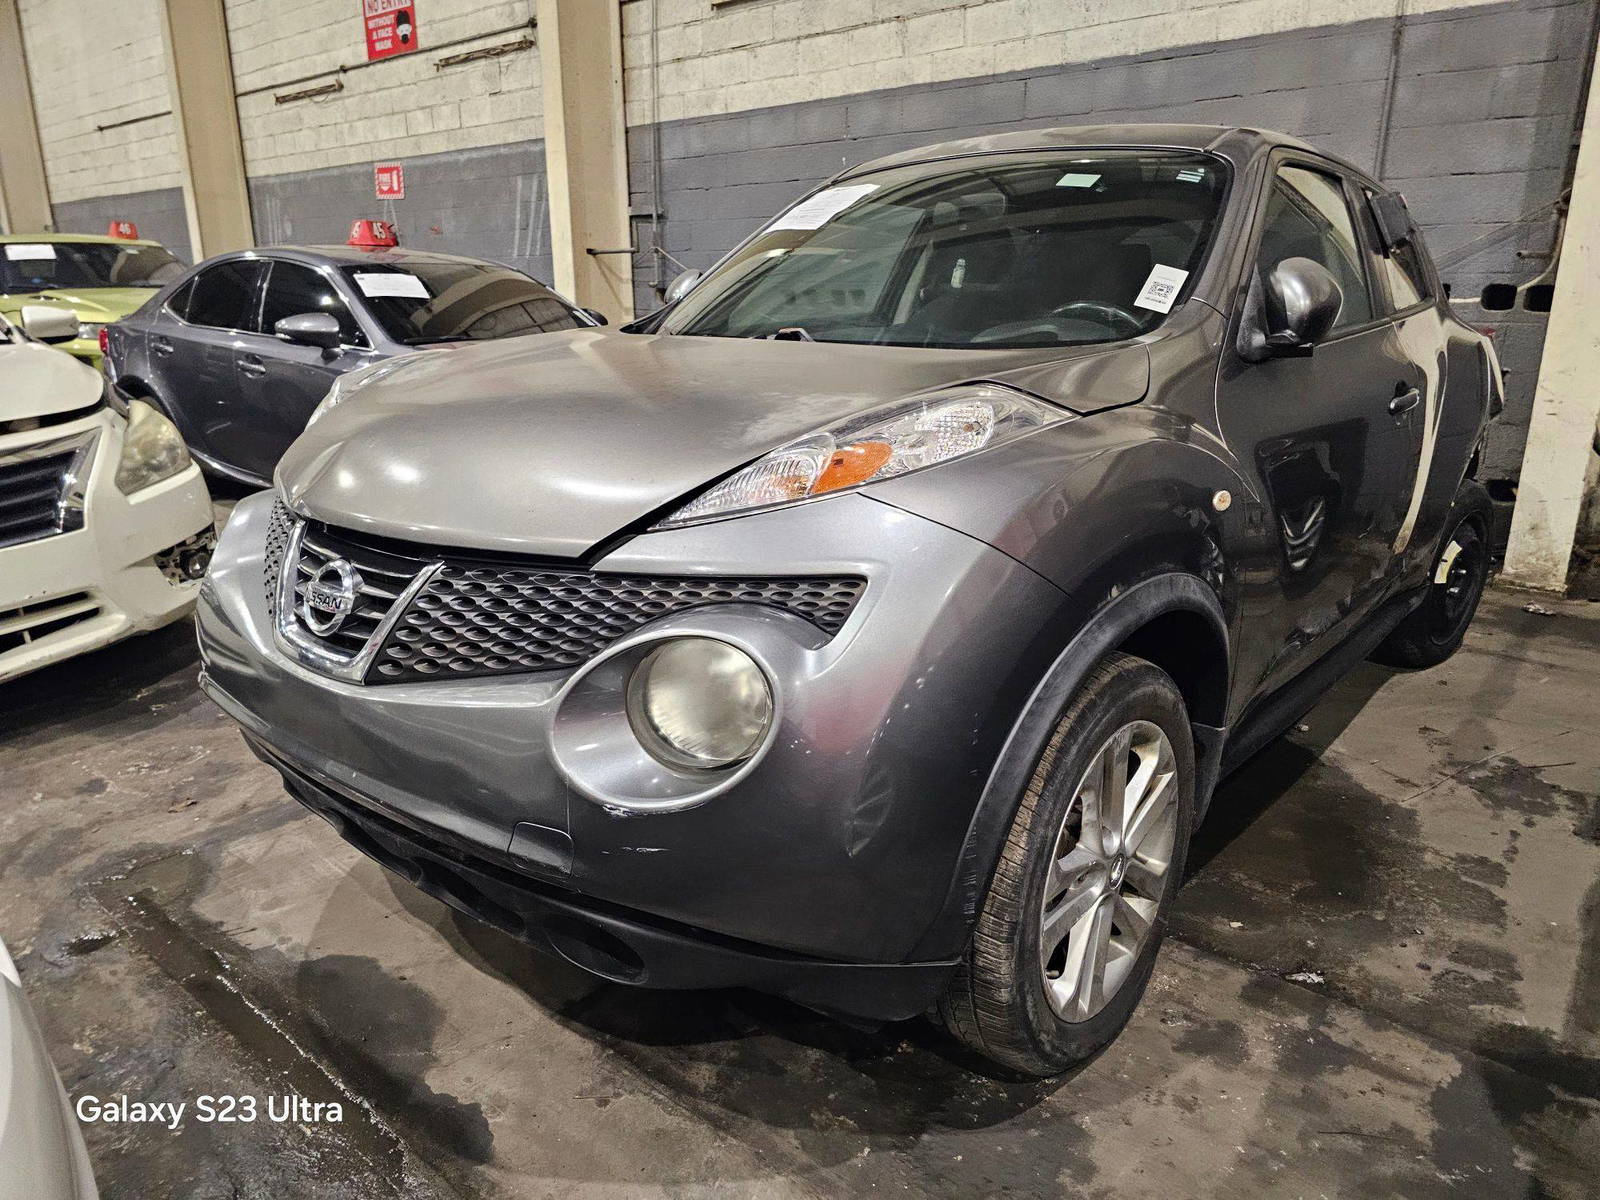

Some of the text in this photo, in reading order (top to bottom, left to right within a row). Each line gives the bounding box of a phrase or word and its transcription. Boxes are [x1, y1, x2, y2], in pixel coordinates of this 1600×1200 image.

[367, 0, 379, 13] NO
[373, 222, 386, 239] 45
[306, 589, 342, 609] SSAN
